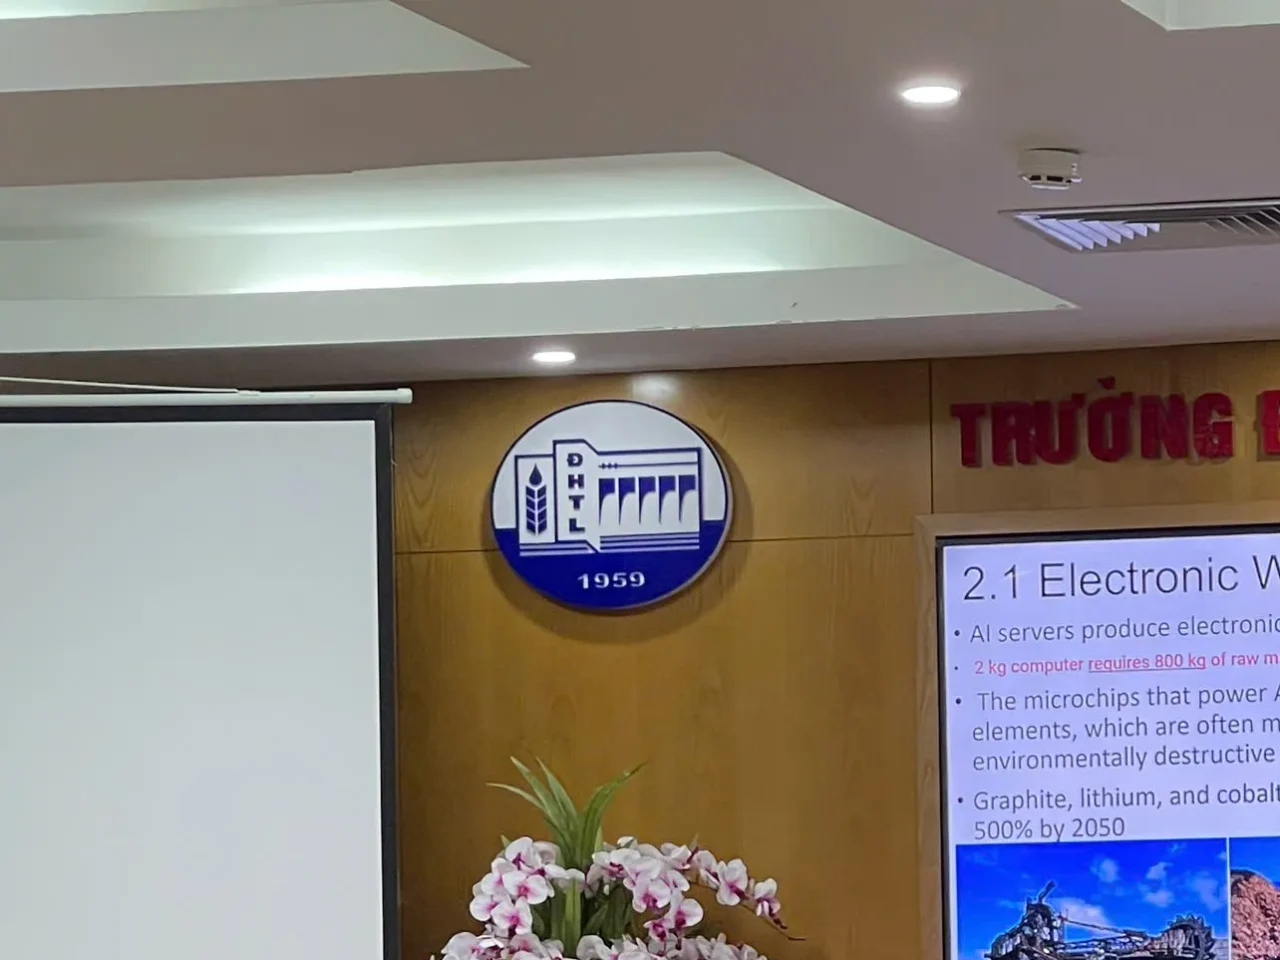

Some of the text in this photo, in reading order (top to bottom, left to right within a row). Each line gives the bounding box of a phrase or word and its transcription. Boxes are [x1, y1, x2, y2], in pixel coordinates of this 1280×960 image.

[951, 375, 1236, 468] TRƯỜNG
[576, 571, 646, 589] 1959
[963, 564, 1018, 600] 2.1
[1040, 556, 1239, 597] Electronic
[969, 624, 990, 643] AI
[998, 624, 1075, 643] servers
[1082, 617, 1170, 643] produce
[974, 660, 984, 675] 2
[988, 659, 1006, 677] kg
[1011, 660, 1083, 678] computer
[1088, 654, 1149, 674] requires
[1155, 653, 1183, 668] 800
[1188, 652, 1206, 671] kg
[1211, 651, 1226, 666] of
[1231, 654, 1259, 666] raw
[977, 691, 1016, 711] The
[1024, 688, 1140, 711] microchips
[1147, 685, 1191, 706] that
[1198, 687, 1267, 709] power
[972, 721, 1077, 743] elements,
[1084, 717, 1148, 739] which
[1155, 719, 1190, 737] are
[1196, 713, 1254, 735] often
[972, 746, 1147, 771] environmentally
[1154, 743, 1275, 767] destructive
[973, 789, 1073, 814] Graphite,
[1081, 787, 1162, 809] lithium,
[1169, 784, 1210, 805] and
[974, 816, 1126, 842] 500% by 2050
